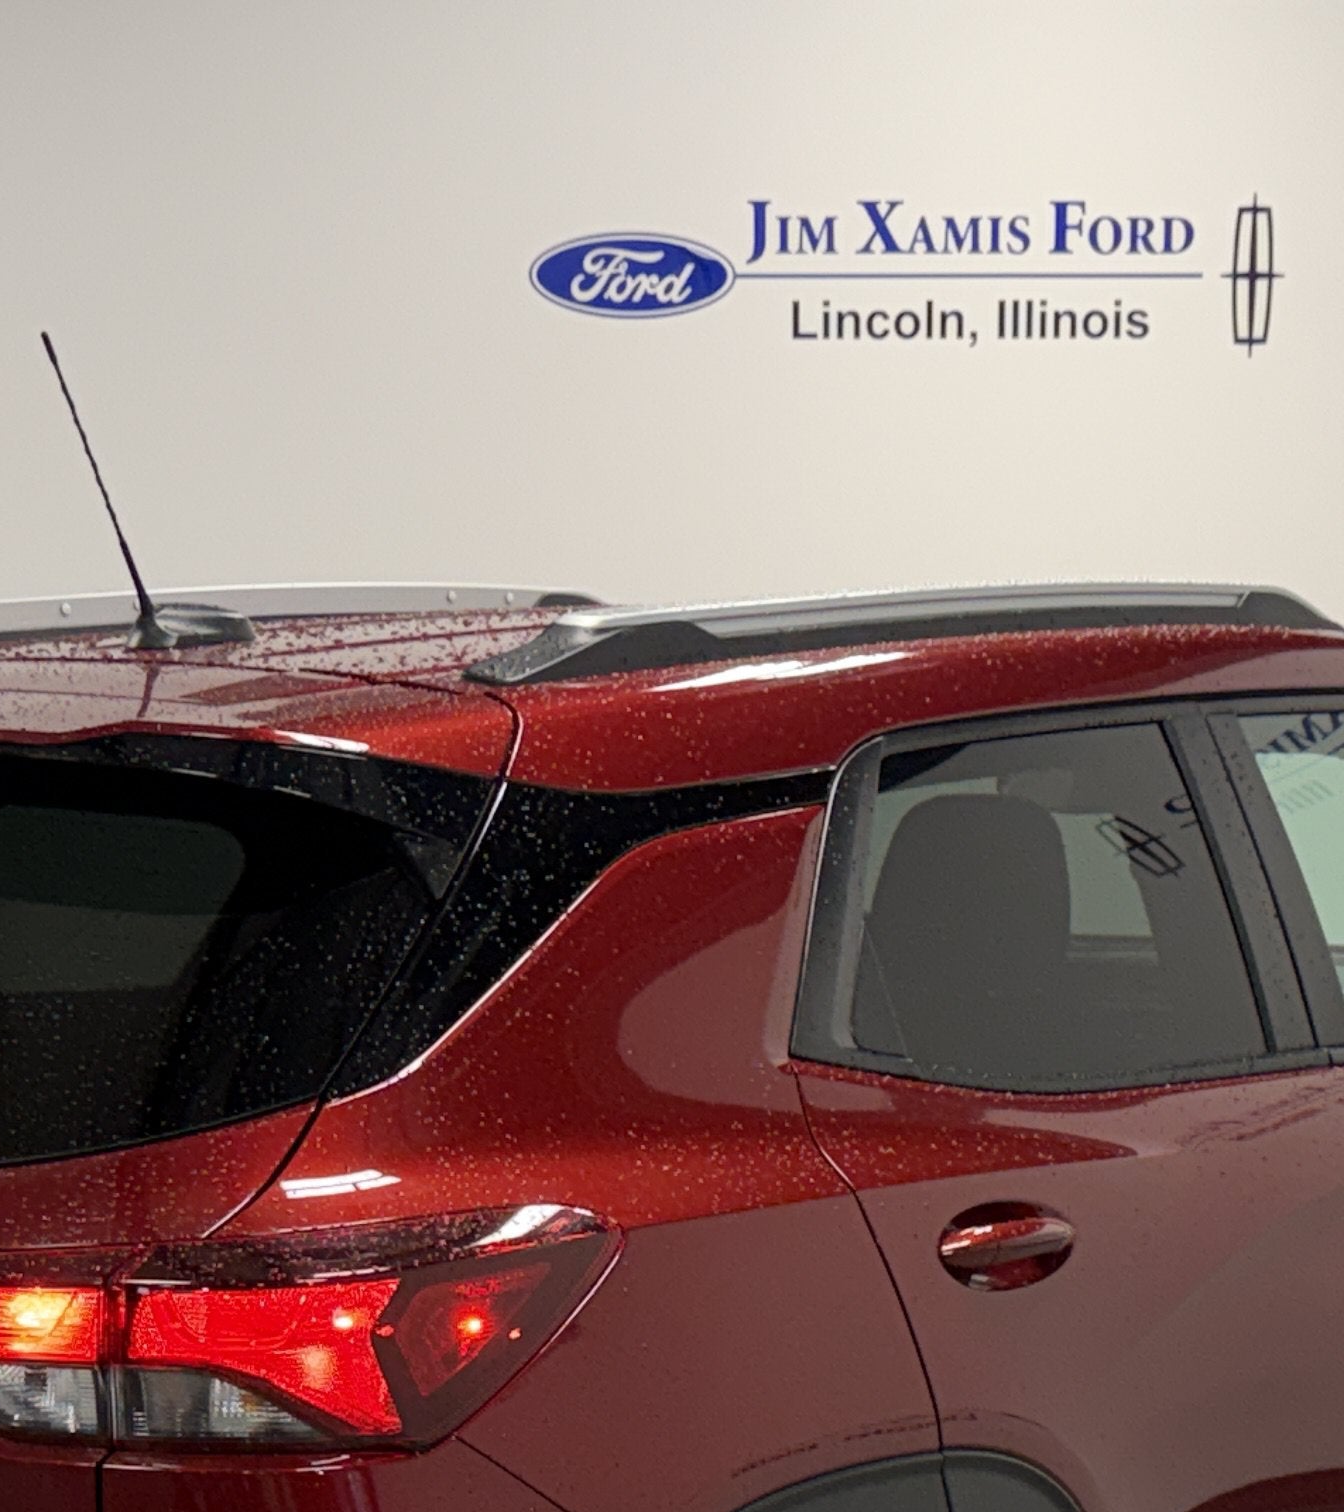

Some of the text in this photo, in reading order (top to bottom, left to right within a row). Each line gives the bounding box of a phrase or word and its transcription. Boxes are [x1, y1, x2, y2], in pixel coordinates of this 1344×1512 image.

[745, 200, 1195, 265] JIM XAMIS FORD
[570, 247, 692, 305] Ford
[791, 299, 1150, 345] Lincoln, Illinois
